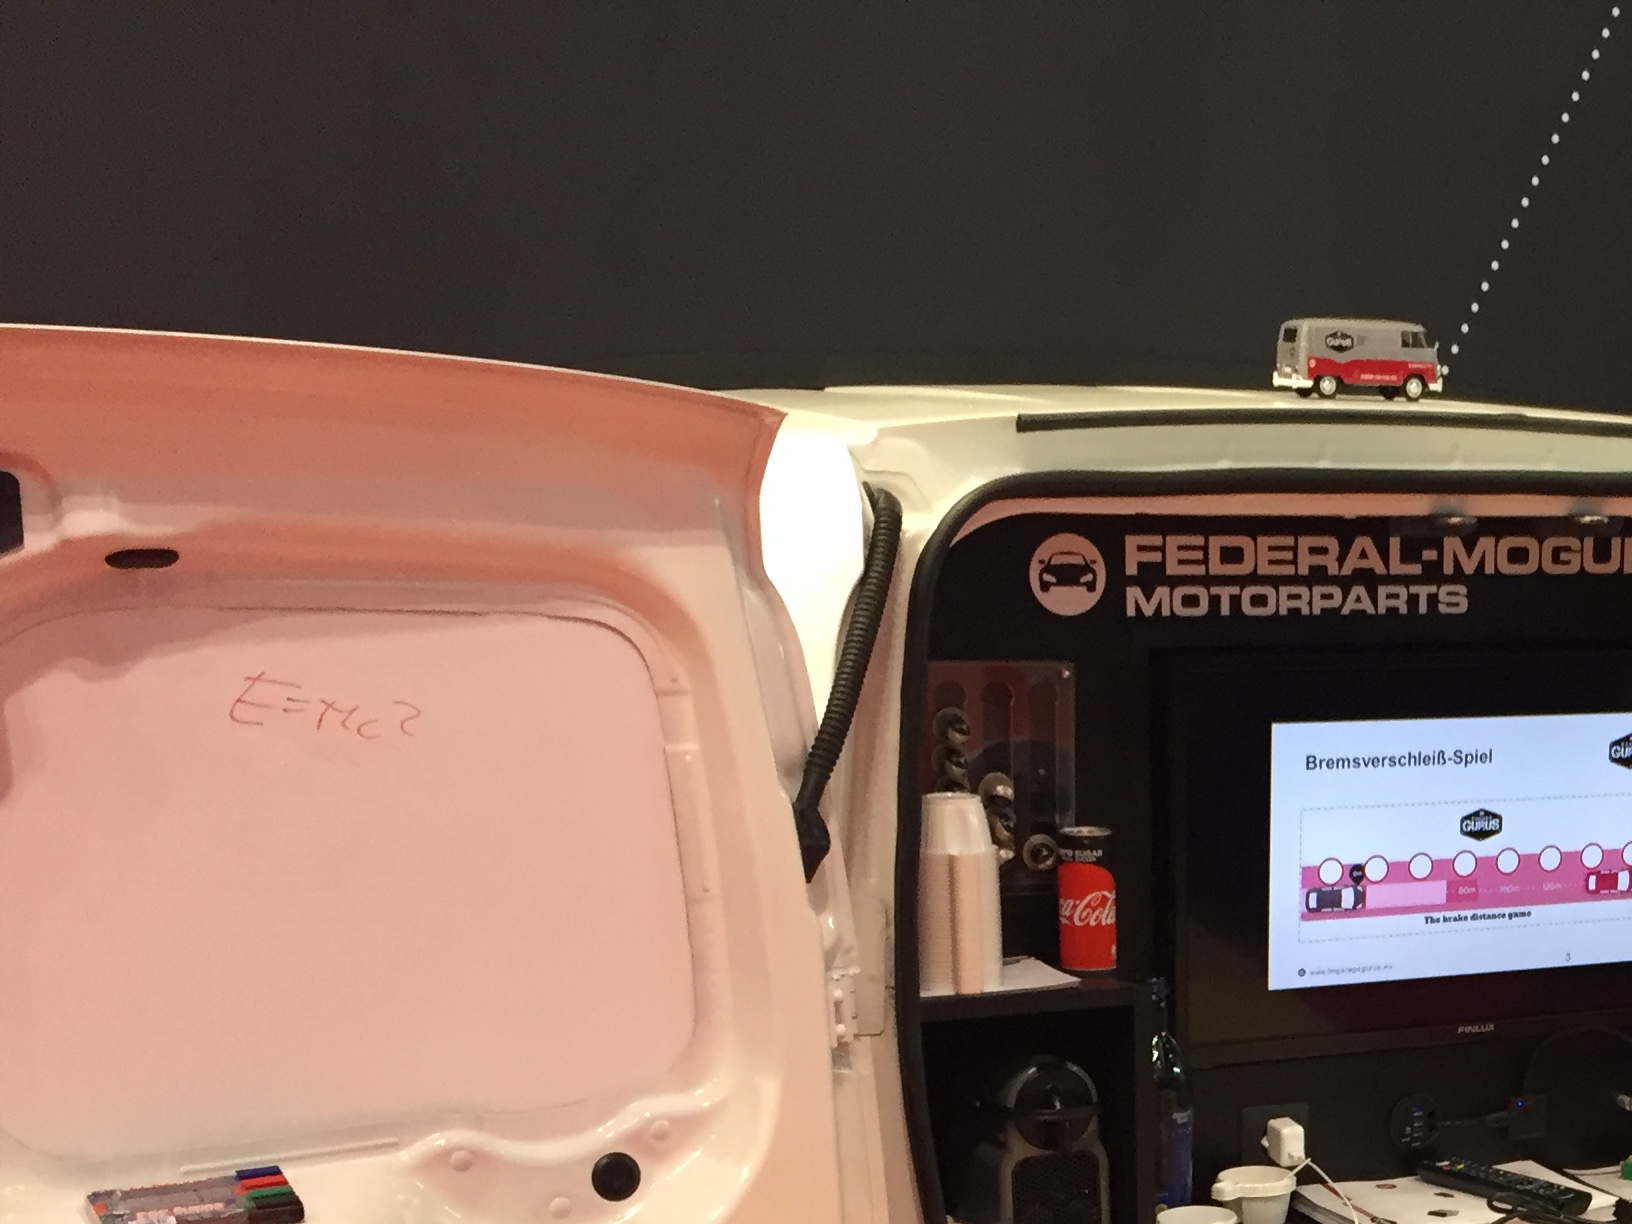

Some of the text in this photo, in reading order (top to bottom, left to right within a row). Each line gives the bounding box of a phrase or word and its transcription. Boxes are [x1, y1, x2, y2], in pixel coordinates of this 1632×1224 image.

[1124, 584, 1468, 617] MOTORPARTS
[1305, 748, 1493, 771] Bremsverschleiß-Spiel
[1424, 910, 1532, 924] The brake distance game
[1565, 952, 1571, 962] 3
